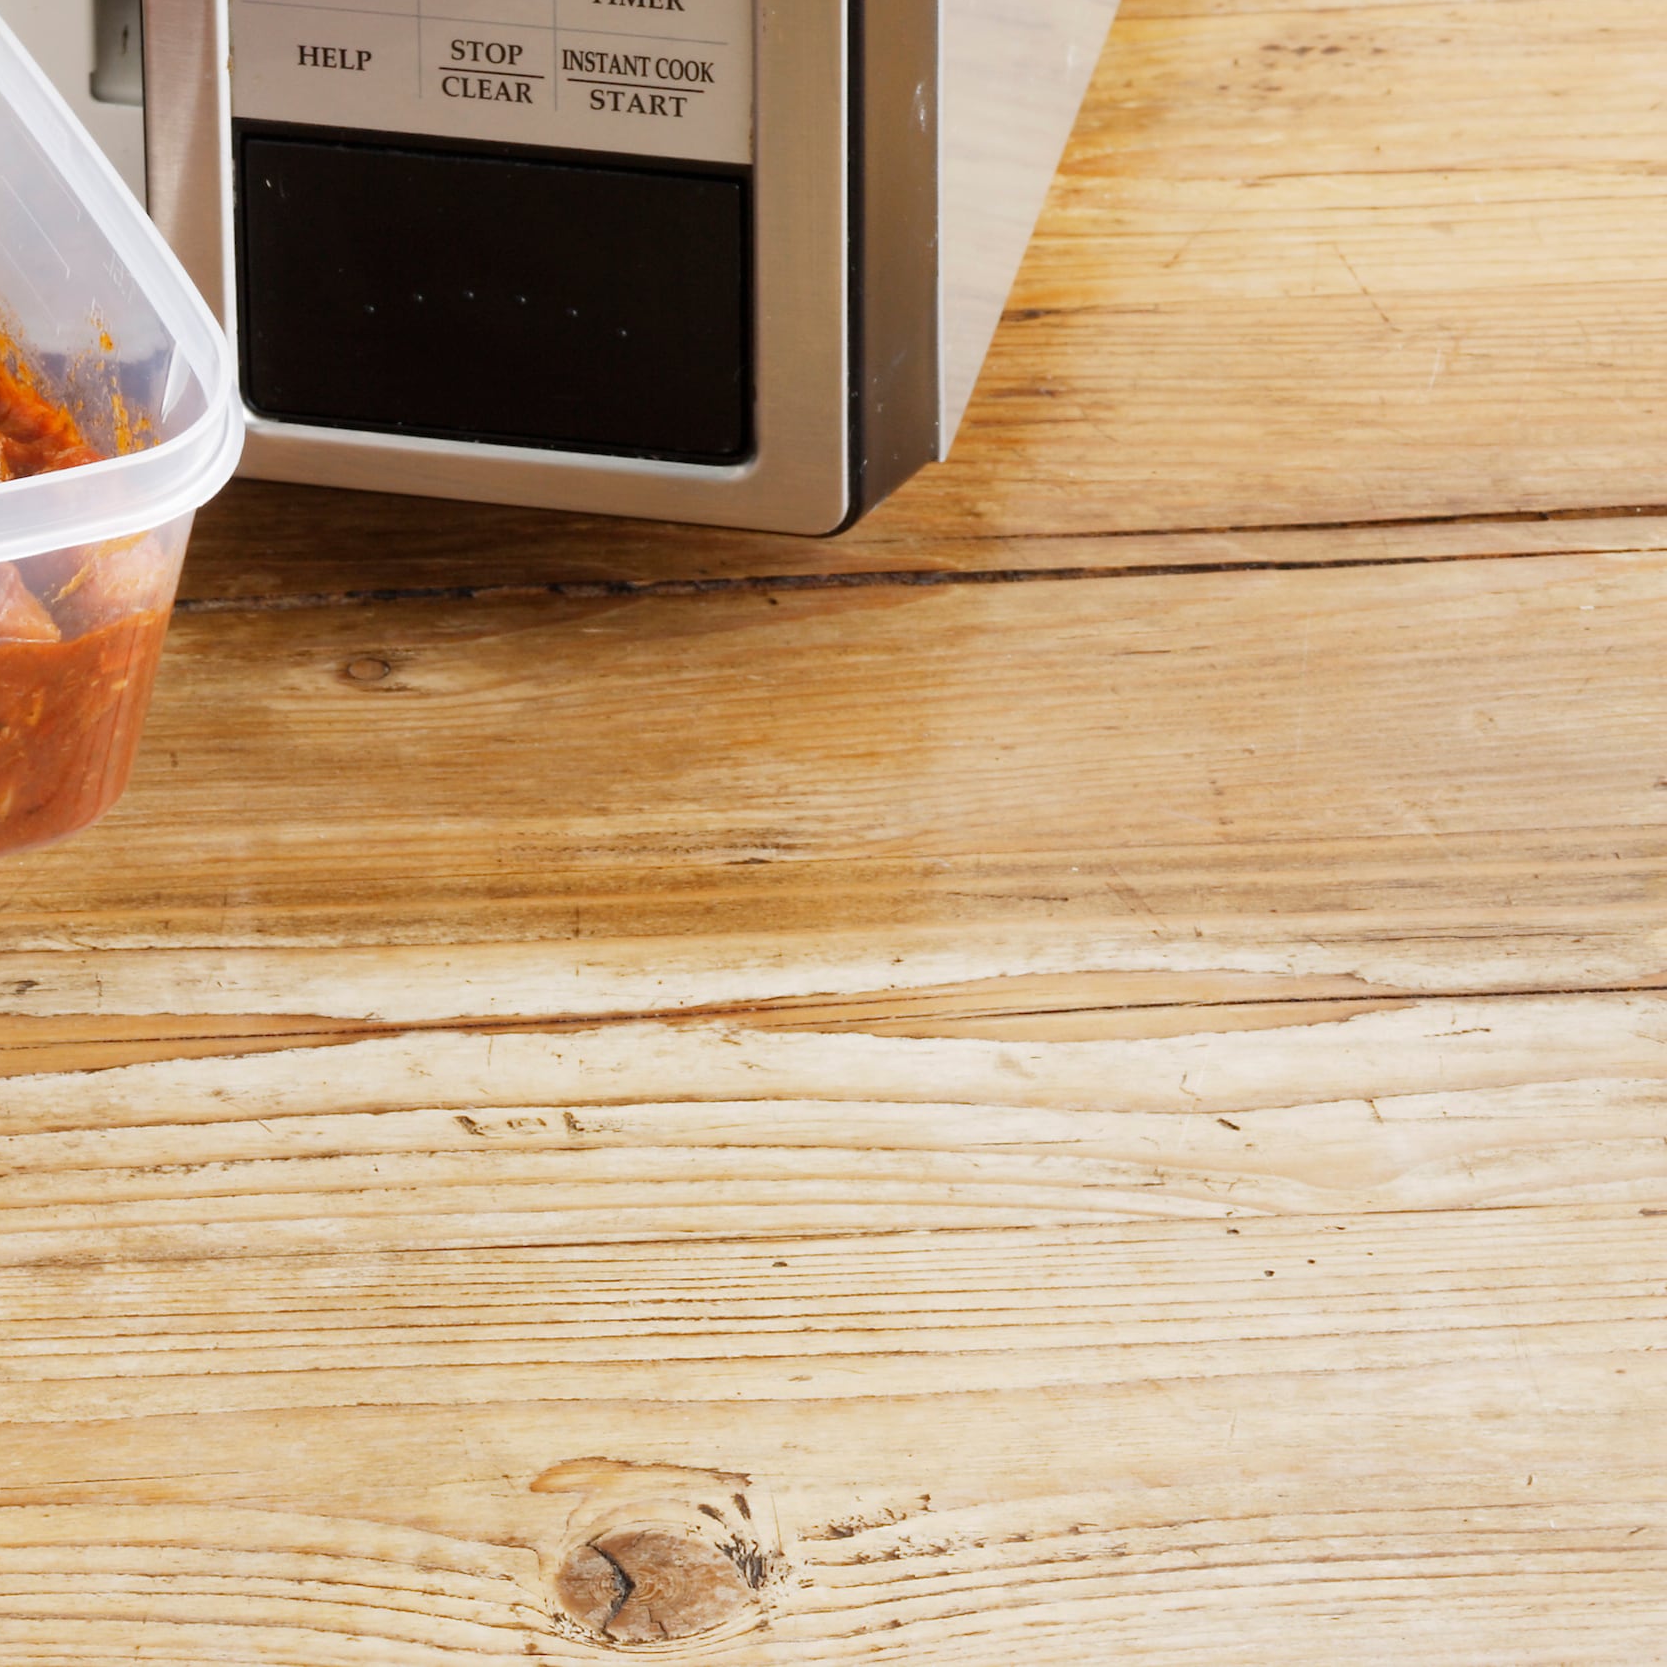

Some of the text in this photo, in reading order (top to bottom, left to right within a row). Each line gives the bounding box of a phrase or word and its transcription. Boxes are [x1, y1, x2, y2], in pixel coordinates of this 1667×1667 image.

[299, 45, 371, 70] HELP
[451, 40, 523, 65] STOP
[563, 49, 714, 83] INSTANT COOK
[442, 76, 533, 104] CLEAR
[590, 89, 687, 117] START
